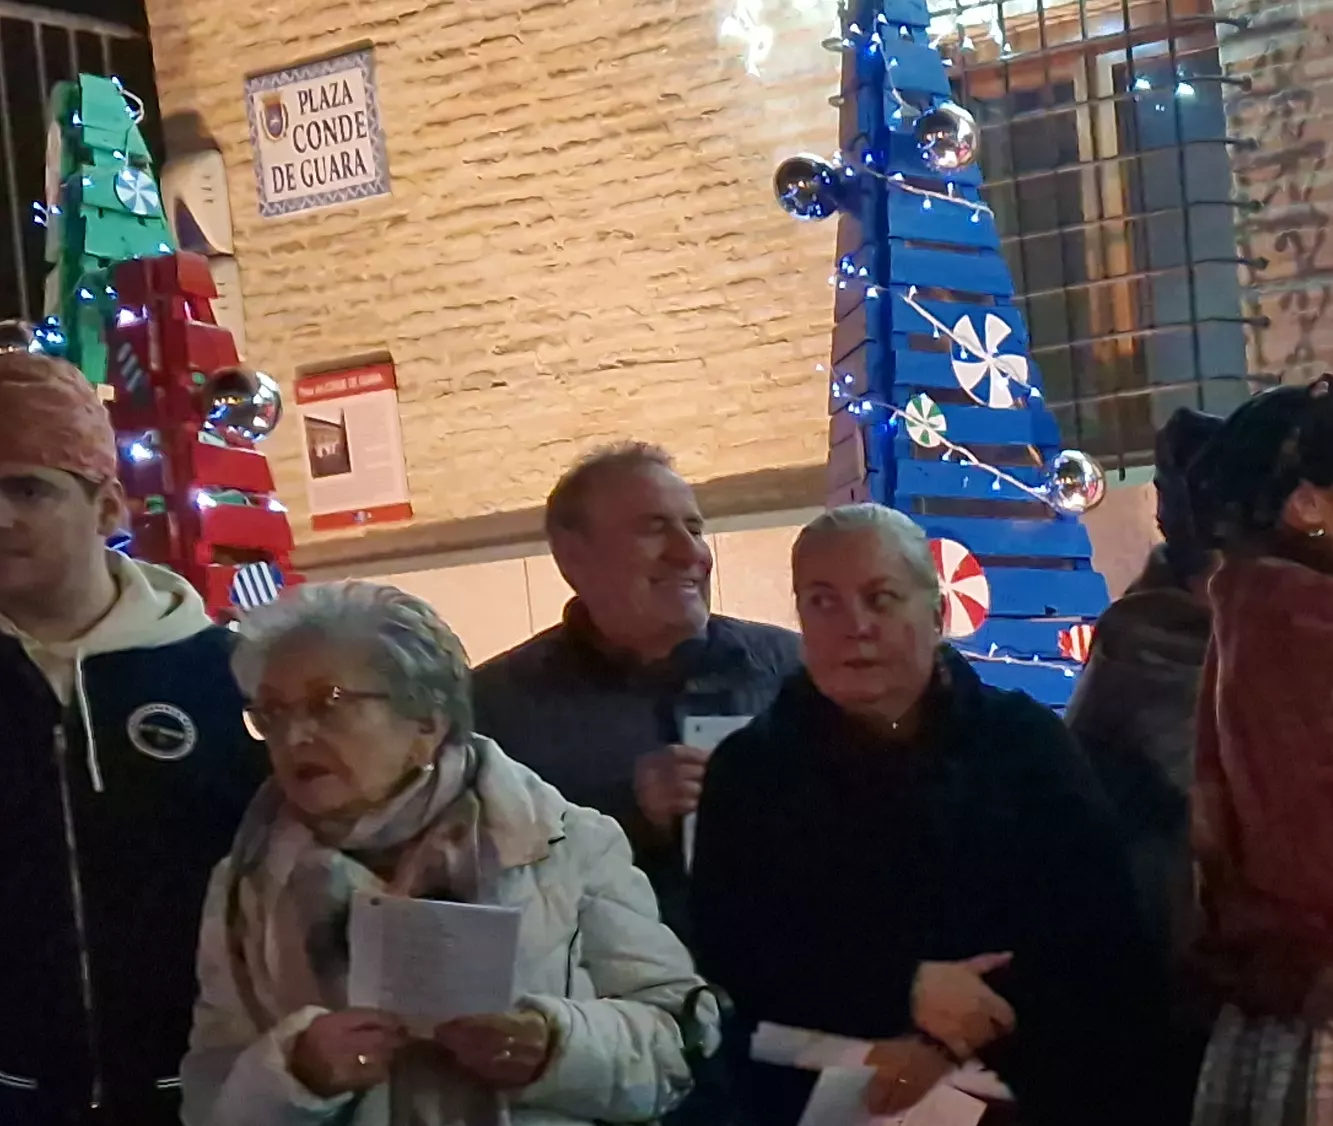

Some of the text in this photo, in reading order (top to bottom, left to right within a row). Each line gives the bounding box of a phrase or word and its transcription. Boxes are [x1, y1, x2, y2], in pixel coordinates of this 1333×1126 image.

[297, 79, 354, 115] PLAZA
[292, 111, 368, 153] CONDE
[271, 148, 368, 194] DE GUARA
